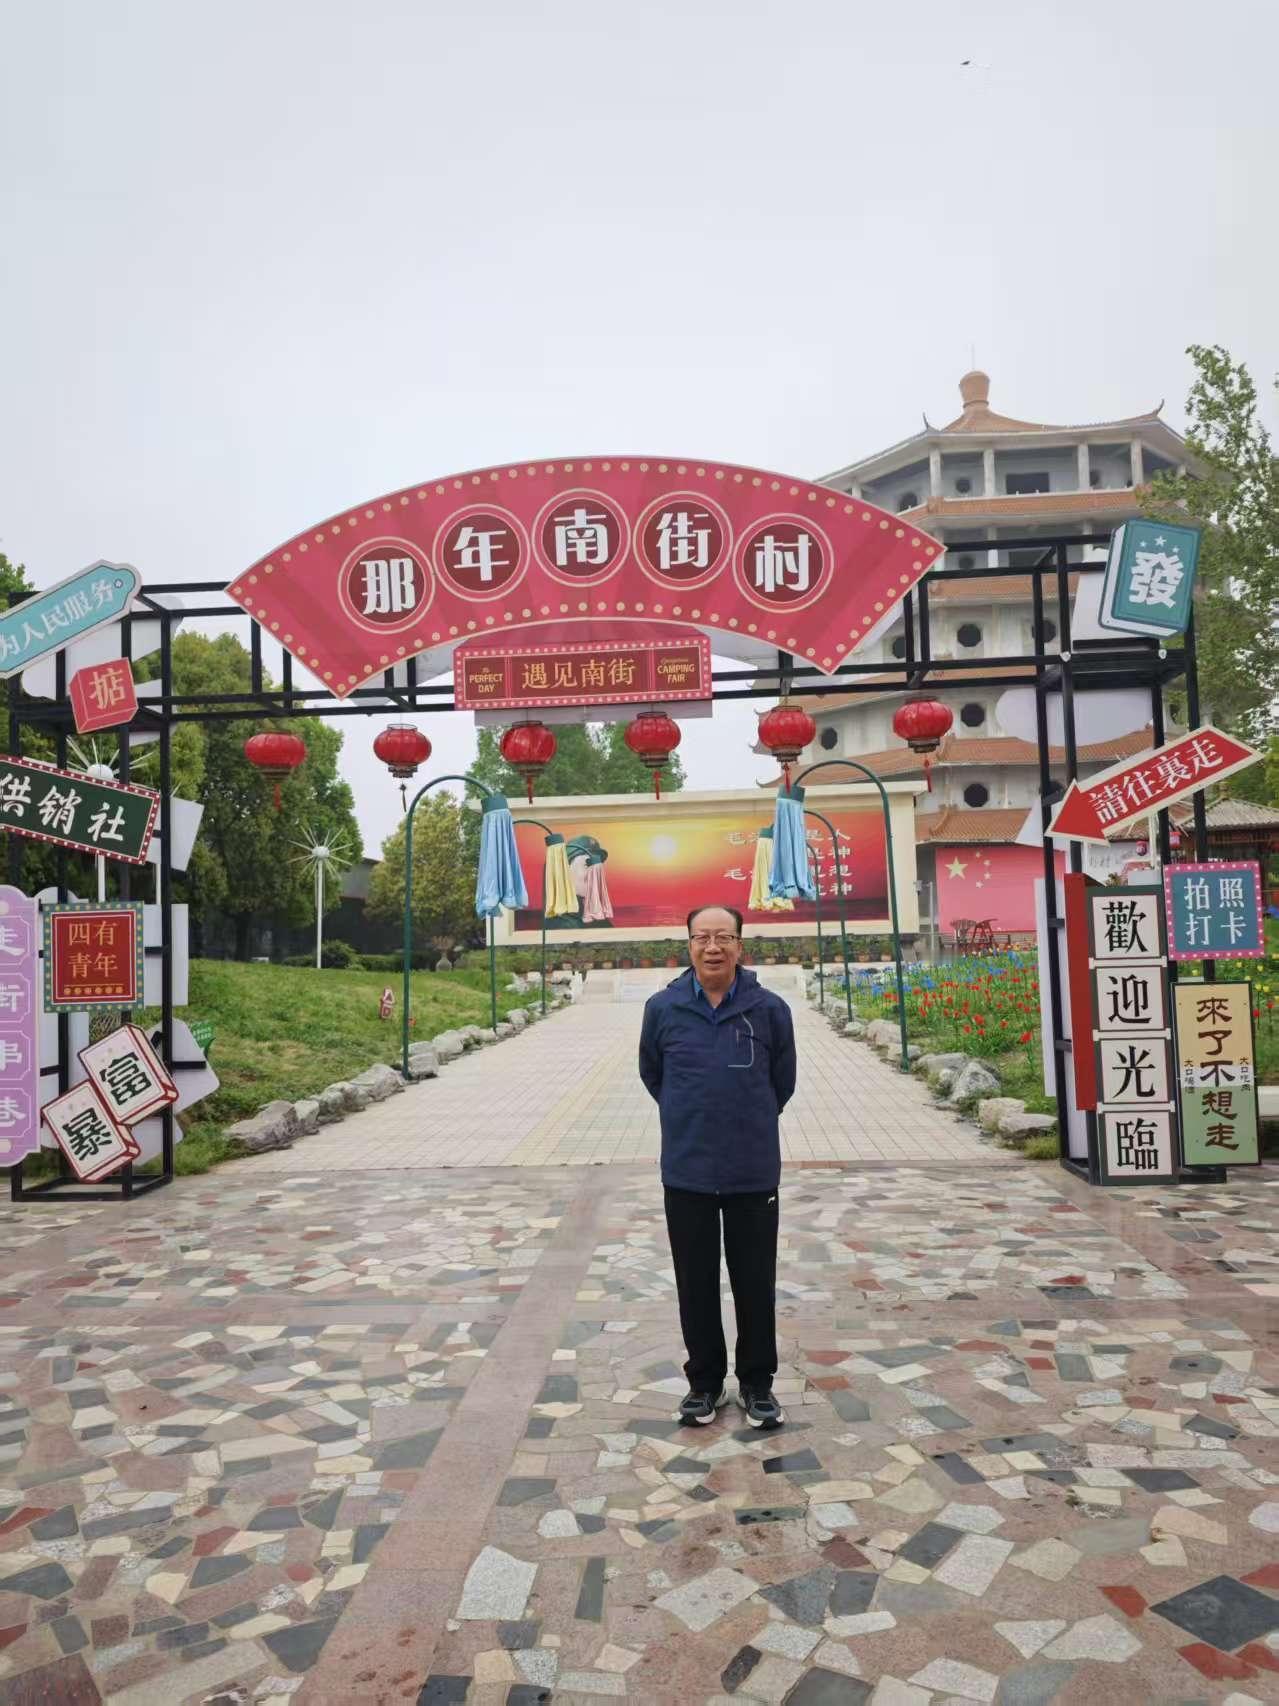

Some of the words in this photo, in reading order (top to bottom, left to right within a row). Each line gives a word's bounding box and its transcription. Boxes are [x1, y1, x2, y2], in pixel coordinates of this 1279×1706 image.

[360, 507, 814, 616] 那年南街村
[1128, 551, 1185, 609] 發
[0, 579, 115, 663] 为人民服务
[469, 673, 503, 683] PERFECT
[478, 684, 495, 693] DAY
[521, 658, 637, 690] 遇见南街
[657, 664, 695, 674] CAMPING
[667, 674, 686, 683] FAIR
[1088, 738, 1224, 824] 請往裏走
[0, 772, 126, 843] 供销社
[1184, 877, 1245, 910] 拍照
[68, 921, 118, 947] 四有
[1184, 911, 1248, 946] 打卡
[68, 951, 118, 980] 青年
[1101, 900, 1160, 1170] 歡迎光臨
[100, 1056, 152, 1106] 富
[1195, 997, 1240, 1151] 來了不想走
[61, 1105, 113, 1162] 暴
